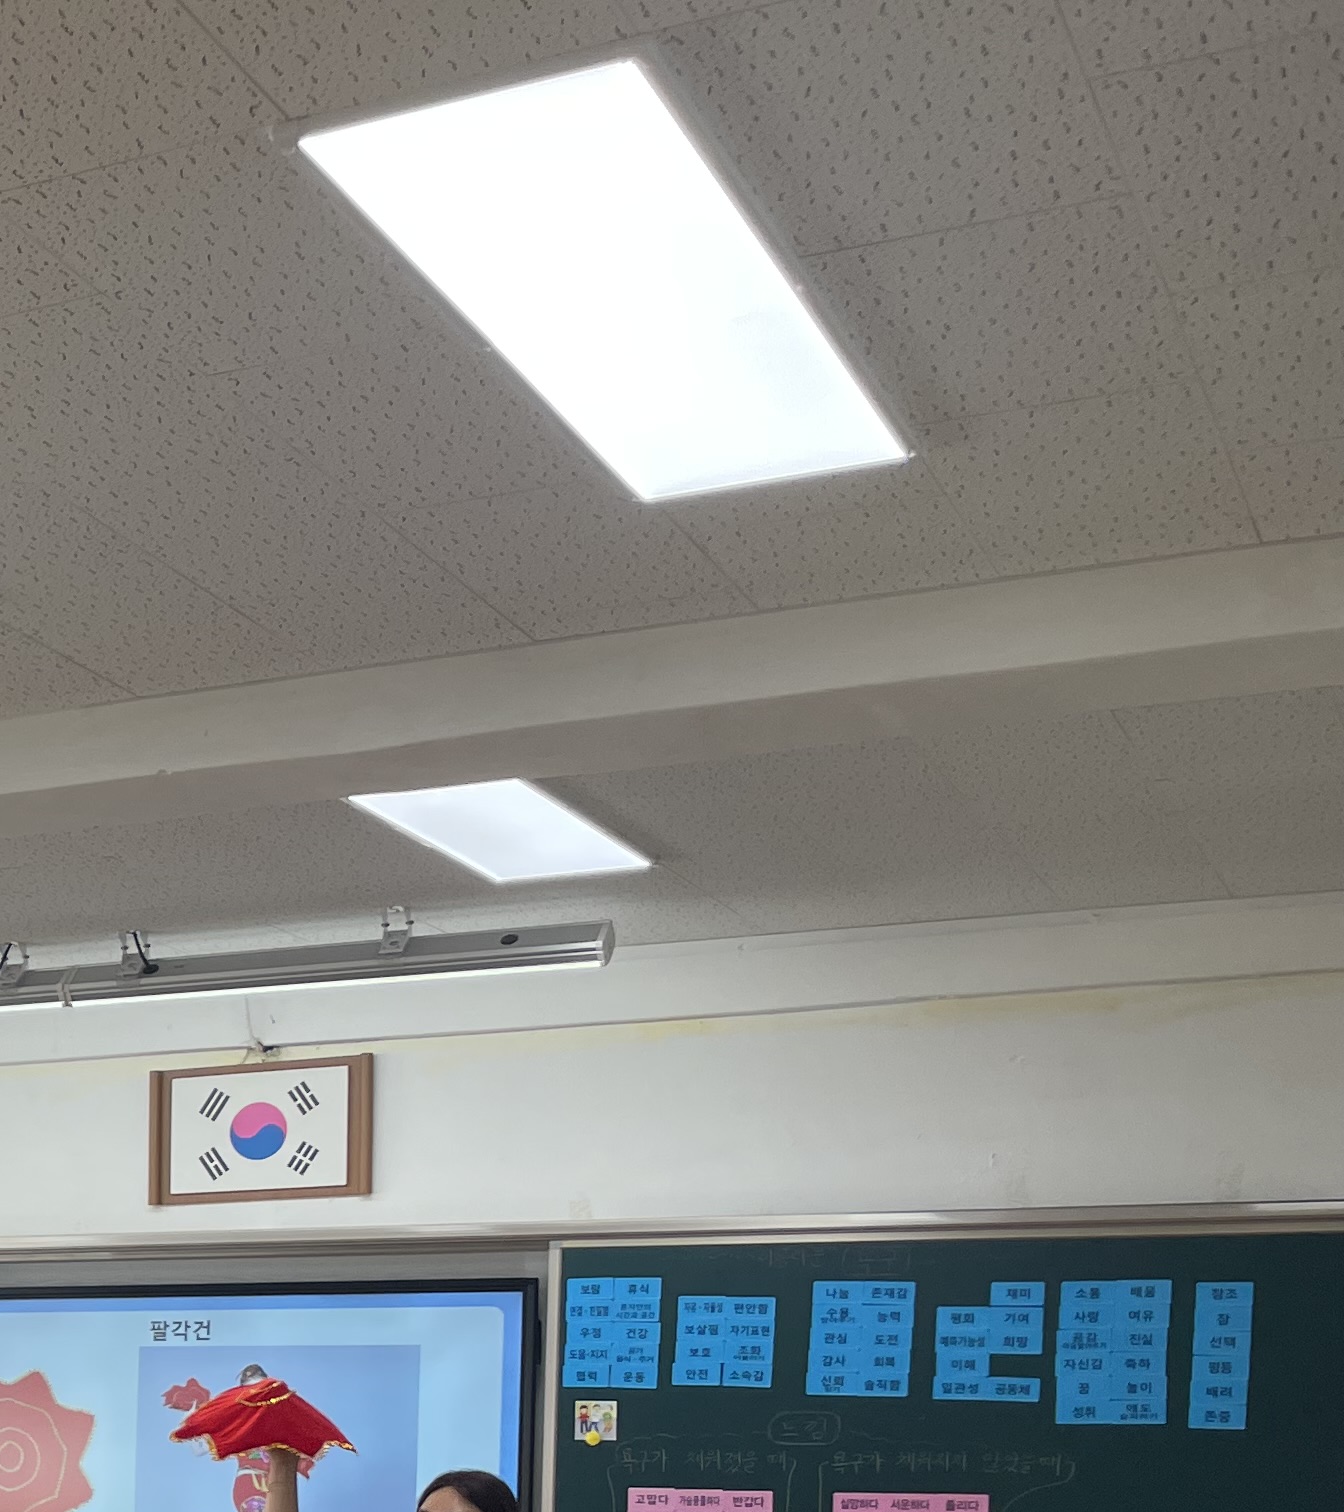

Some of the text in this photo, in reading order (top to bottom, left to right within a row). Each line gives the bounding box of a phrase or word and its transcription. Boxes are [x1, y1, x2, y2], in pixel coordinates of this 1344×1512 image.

[628, 1284, 649, 1294] 휴식
[826, 1288, 849, 1298] 나눔
[871, 1288, 907, 1298] 존재감
[1006, 1289, 1030, 1299] 재미
[734, 1304, 768, 1314] 편안함
[827, 1308, 848, 1318] 수용
[877, 1311, 901, 1322] 능력
[1004, 1313, 1029, 1324] 기여
[1074, 1311, 1099, 1323] 사랑
[1129, 1310, 1154, 1322] 여유
[1217, 1314, 1230, 1326] 잠
[149, 1319, 212, 1342] 팔각건
[580, 1328, 602, 1338] 우정
[626, 1328, 648, 1339] 건강
[684, 1325, 719, 1335] 보살핌
[730, 1325, 770, 1336] 자기표현
[825, 1334, 847, 1344] 관심
[875, 1334, 898, 1346] 도전
[1004, 1337, 1028, 1348] 희망
[1129, 1334, 1153, 1345] 진실
[1210, 1337, 1236, 1349] 선택
[689, 1348, 711, 1357] 보호
[822, 1356, 845, 1366] 감사
[951, 1360, 975, 1371] 이해
[1064, 1359, 1102, 1370] 자신감
[1125, 1359, 1150, 1369] 축하
[576, 1371, 597, 1381] 협력
[623, 1372, 645, 1383] 운동
[686, 1369, 708, 1380] 안전
[729, 1371, 764, 1381] 소속감
[865, 1380, 900, 1391] 솔직함
[941, 1383, 978, 1395] 일관성
[1078, 1383, 1089, 1394] 꿈
[1127, 1383, 1152, 1394] 놀이
[1206, 1387, 1232, 1398] 배려
[1072, 1407, 1096, 1419] 성취
[635, 1495, 669, 1505] 고맙다
[733, 1497, 764, 1507] 반갑다
[841, 1499, 878, 1510] 실망하다
[891, 1499, 929, 1510] 서운하다
